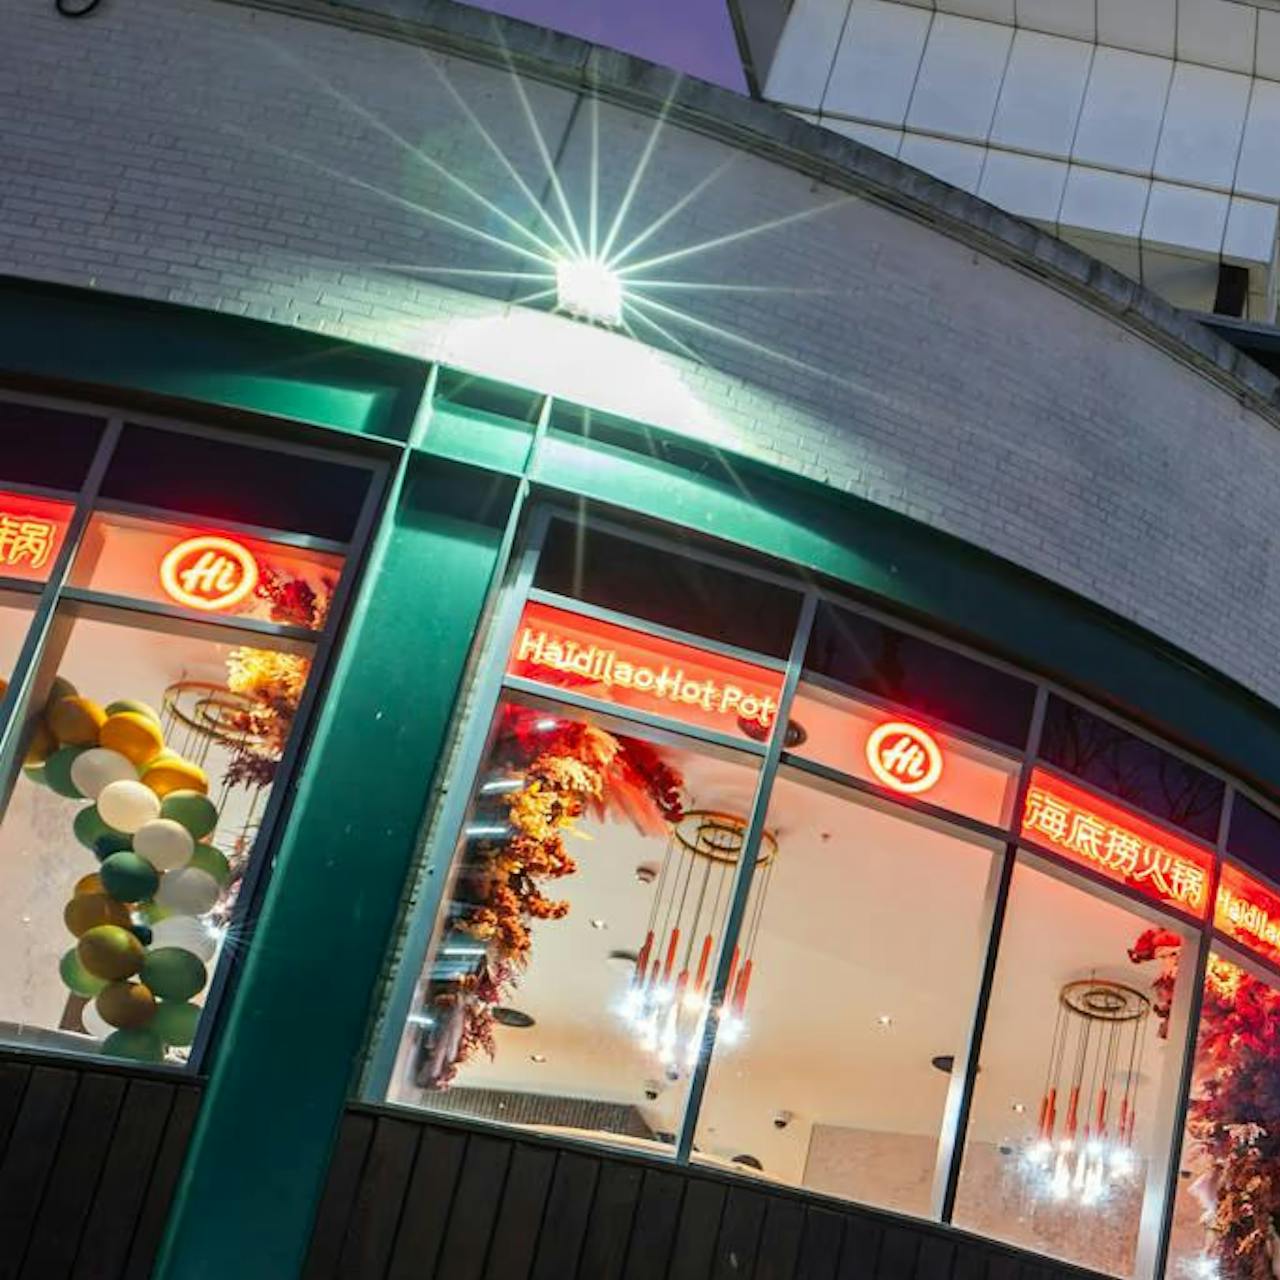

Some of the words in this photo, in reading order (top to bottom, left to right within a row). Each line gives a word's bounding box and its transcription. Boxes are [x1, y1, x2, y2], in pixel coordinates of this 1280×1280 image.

[516, 627, 656, 692] Haidilao
[654, 664, 716, 712] Hot
[717, 684, 779, 728] Pot
[1023, 788, 1206, 909] 海底捞火锅
